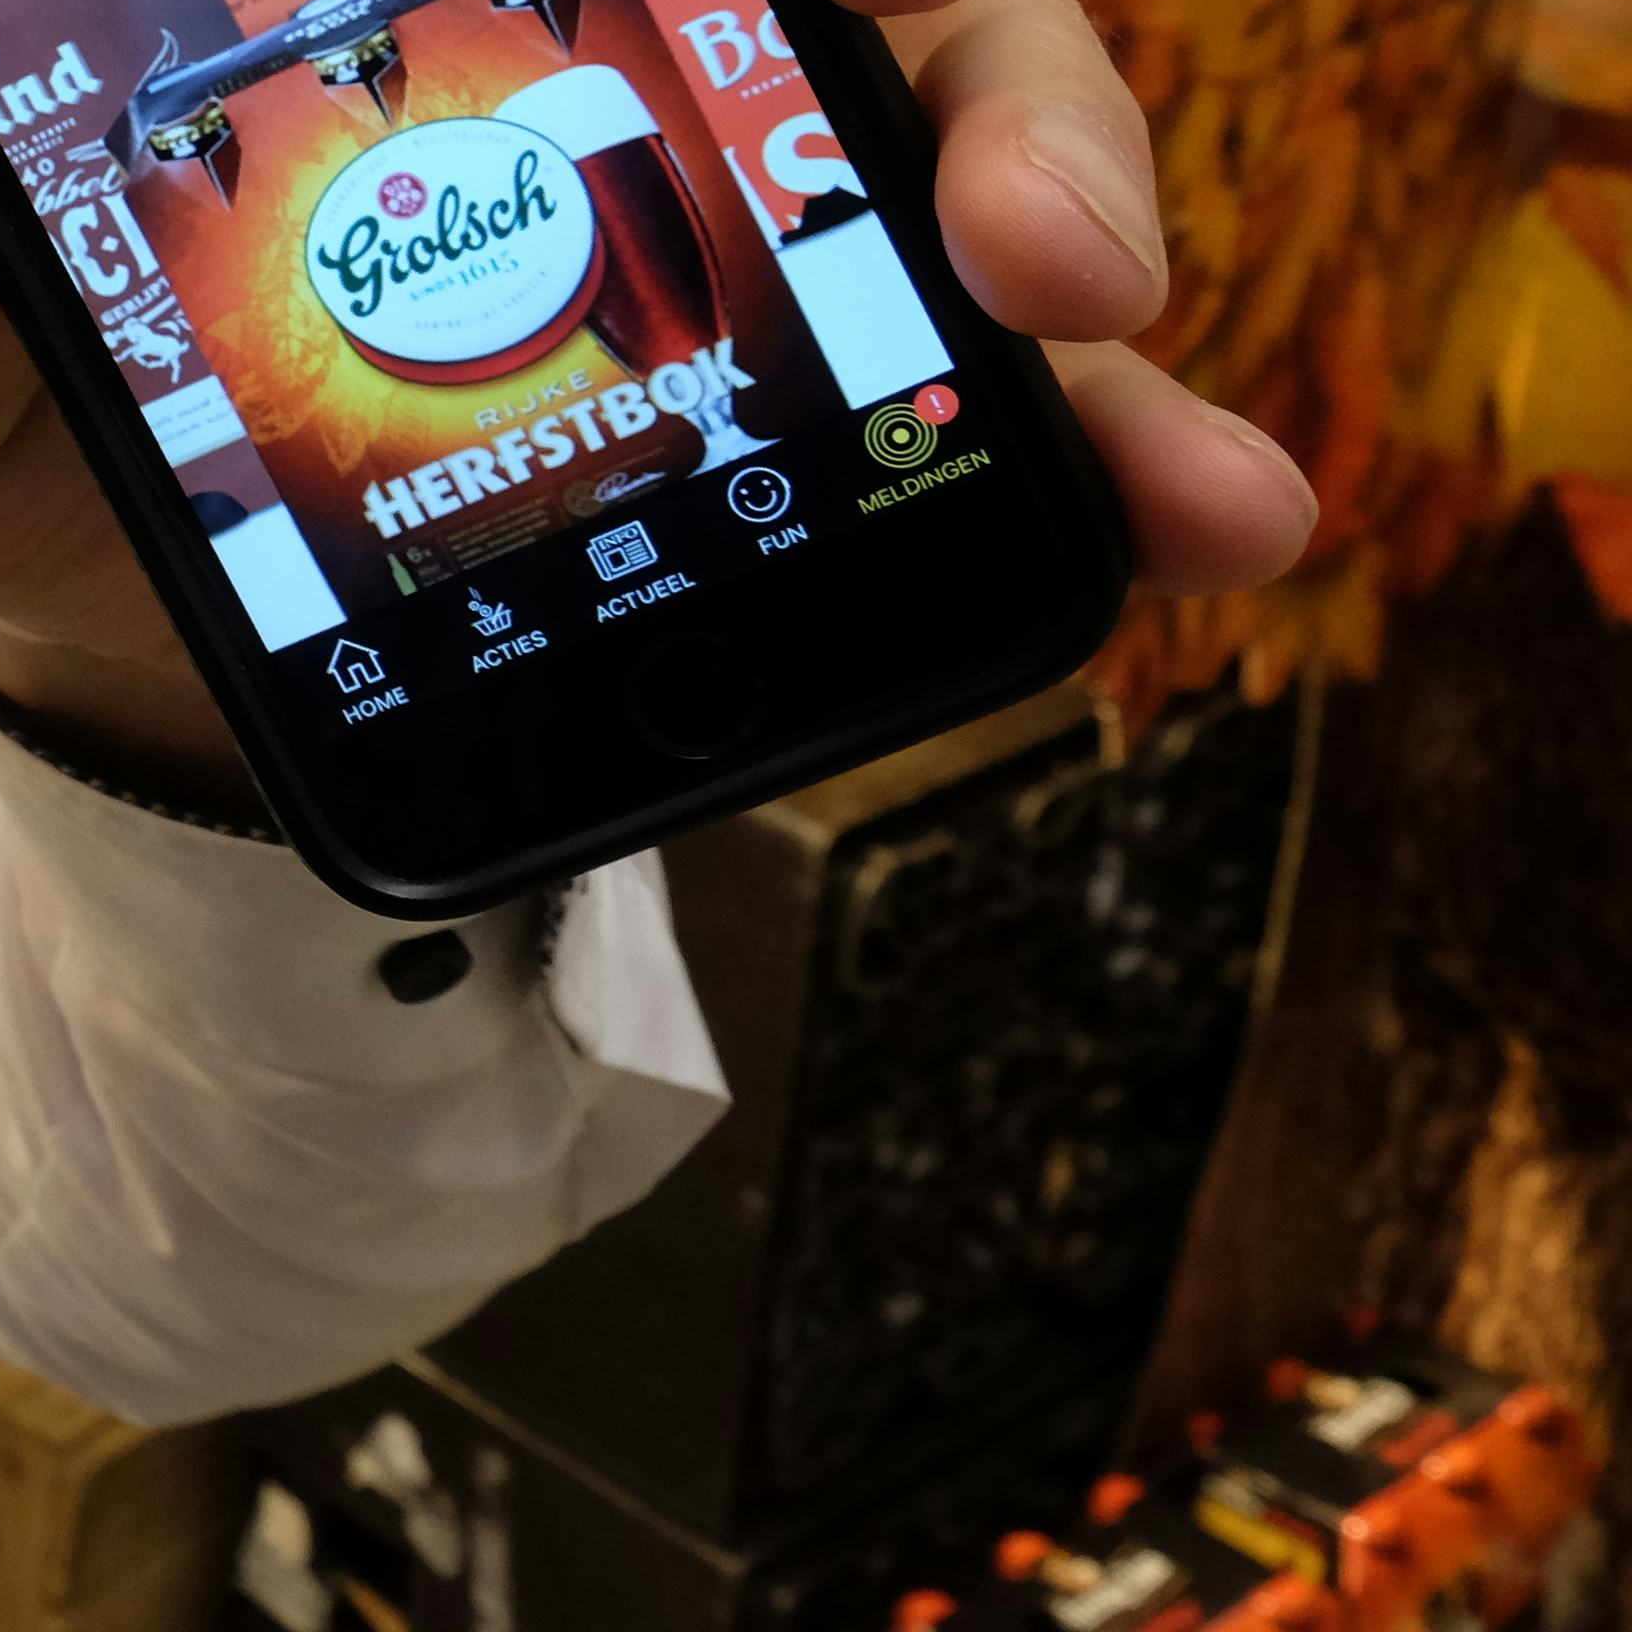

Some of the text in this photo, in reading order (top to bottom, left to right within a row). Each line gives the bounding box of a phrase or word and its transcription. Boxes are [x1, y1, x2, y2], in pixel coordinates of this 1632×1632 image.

[317, 149, 557, 317] Grolsch
[473, 368, 594, 432] RIJKE
[362, 336, 758, 539] HERFSTBOK
[857, 448, 992, 515] MELDINGEN
[756, 523, 809, 555] FUN
[596, 571, 697, 623] ACTUEEL
[471, 629, 549, 673] ACTIES
[342, 685, 410, 725] HOME
